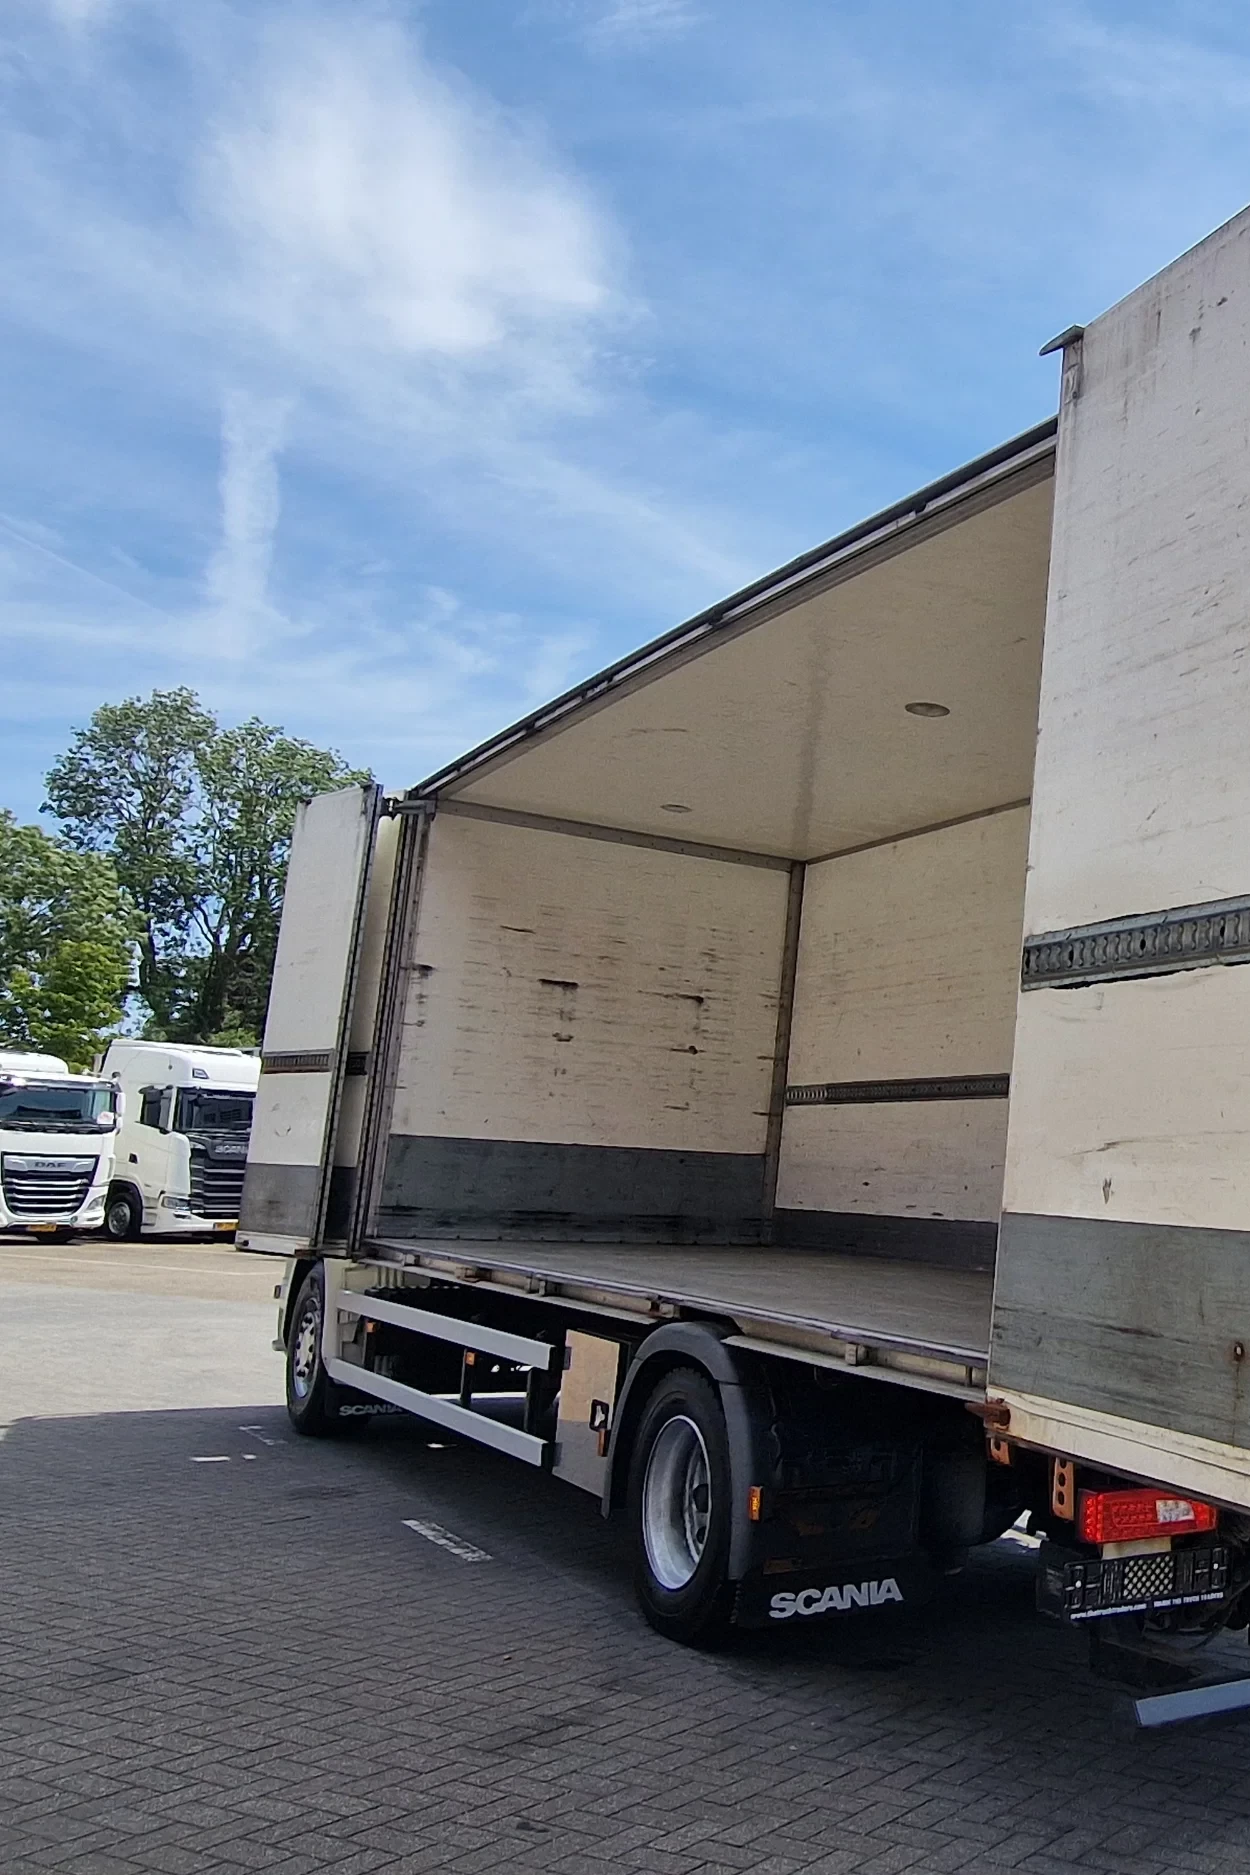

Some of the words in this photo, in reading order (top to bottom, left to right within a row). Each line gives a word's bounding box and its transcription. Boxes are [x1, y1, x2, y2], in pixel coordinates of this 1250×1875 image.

[34, 1161, 67, 1169] DAF
[339, 1403, 404, 1417] SCANIA
[768, 1577, 905, 1619] SCANIA
